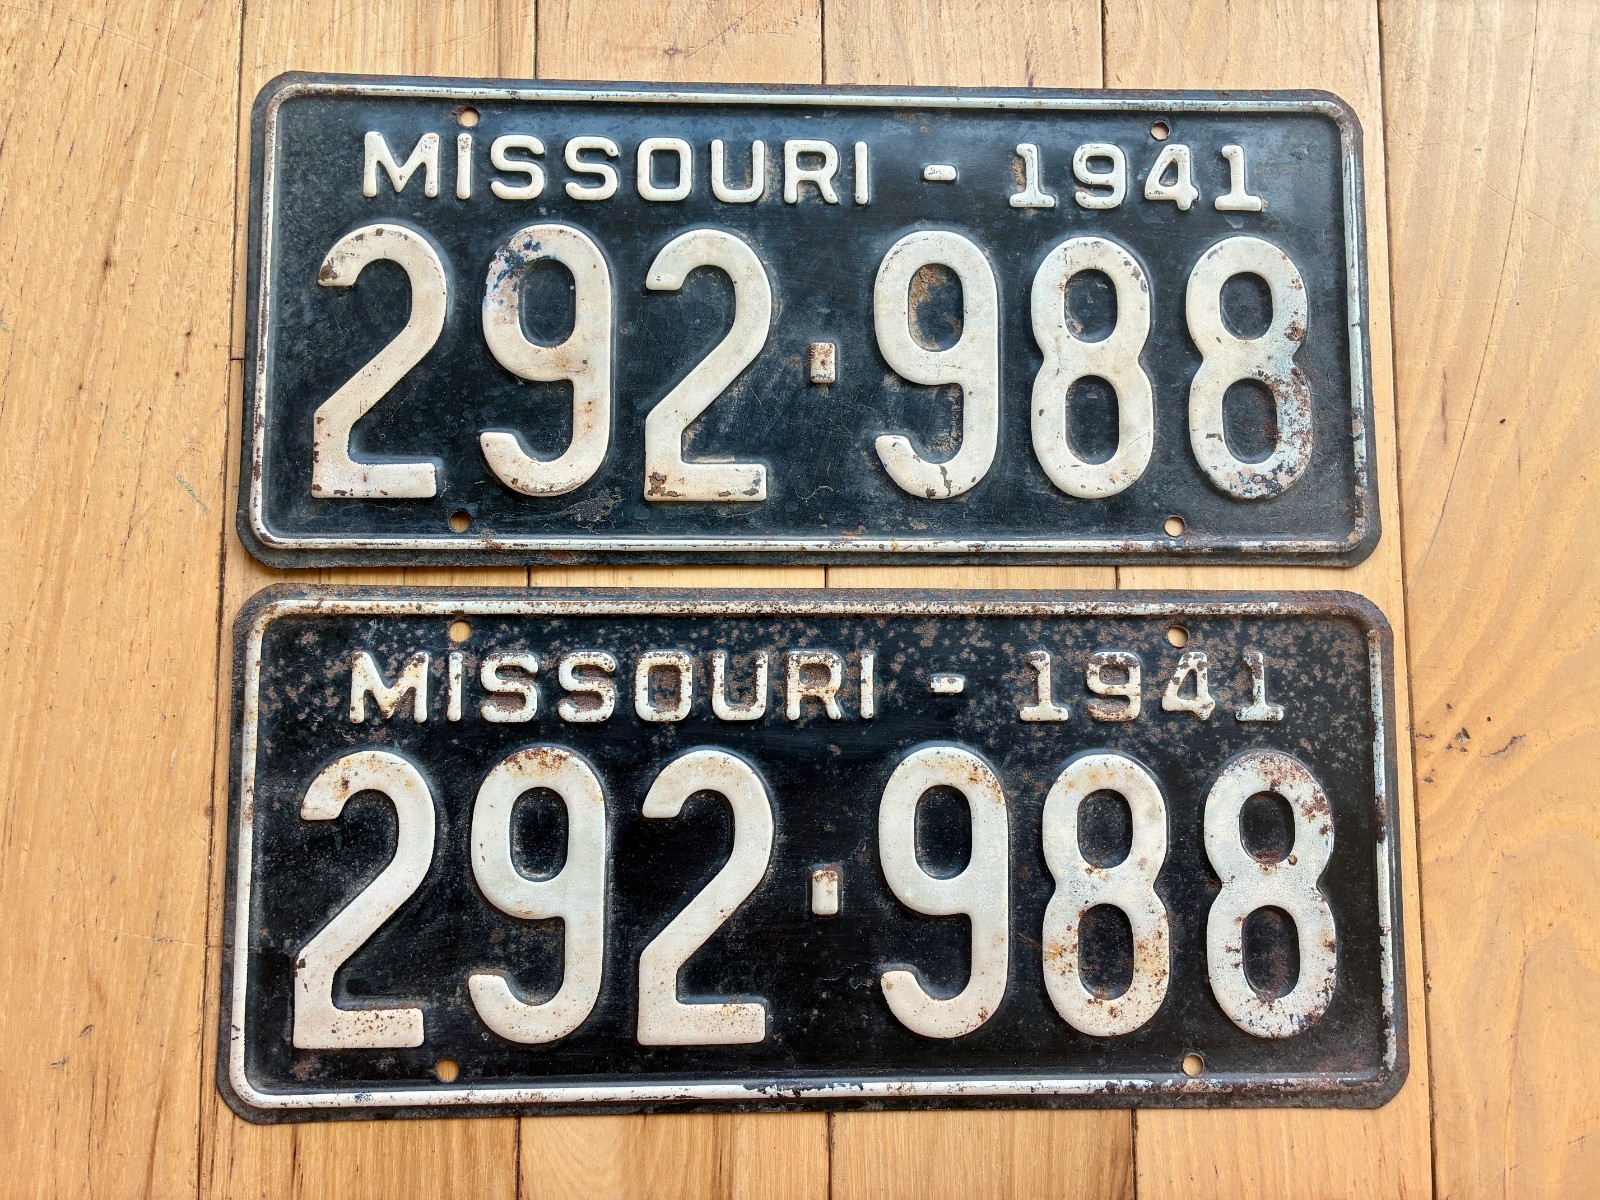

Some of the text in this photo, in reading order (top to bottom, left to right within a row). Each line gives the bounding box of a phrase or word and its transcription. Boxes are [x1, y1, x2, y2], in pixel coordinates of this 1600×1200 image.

[363, 131, 870, 205] MISSOURI
[1008, 142, 1264, 212] 1941
[349, 649, 876, 724] MISSOURI
[1018, 649, 1285, 722] 1941
